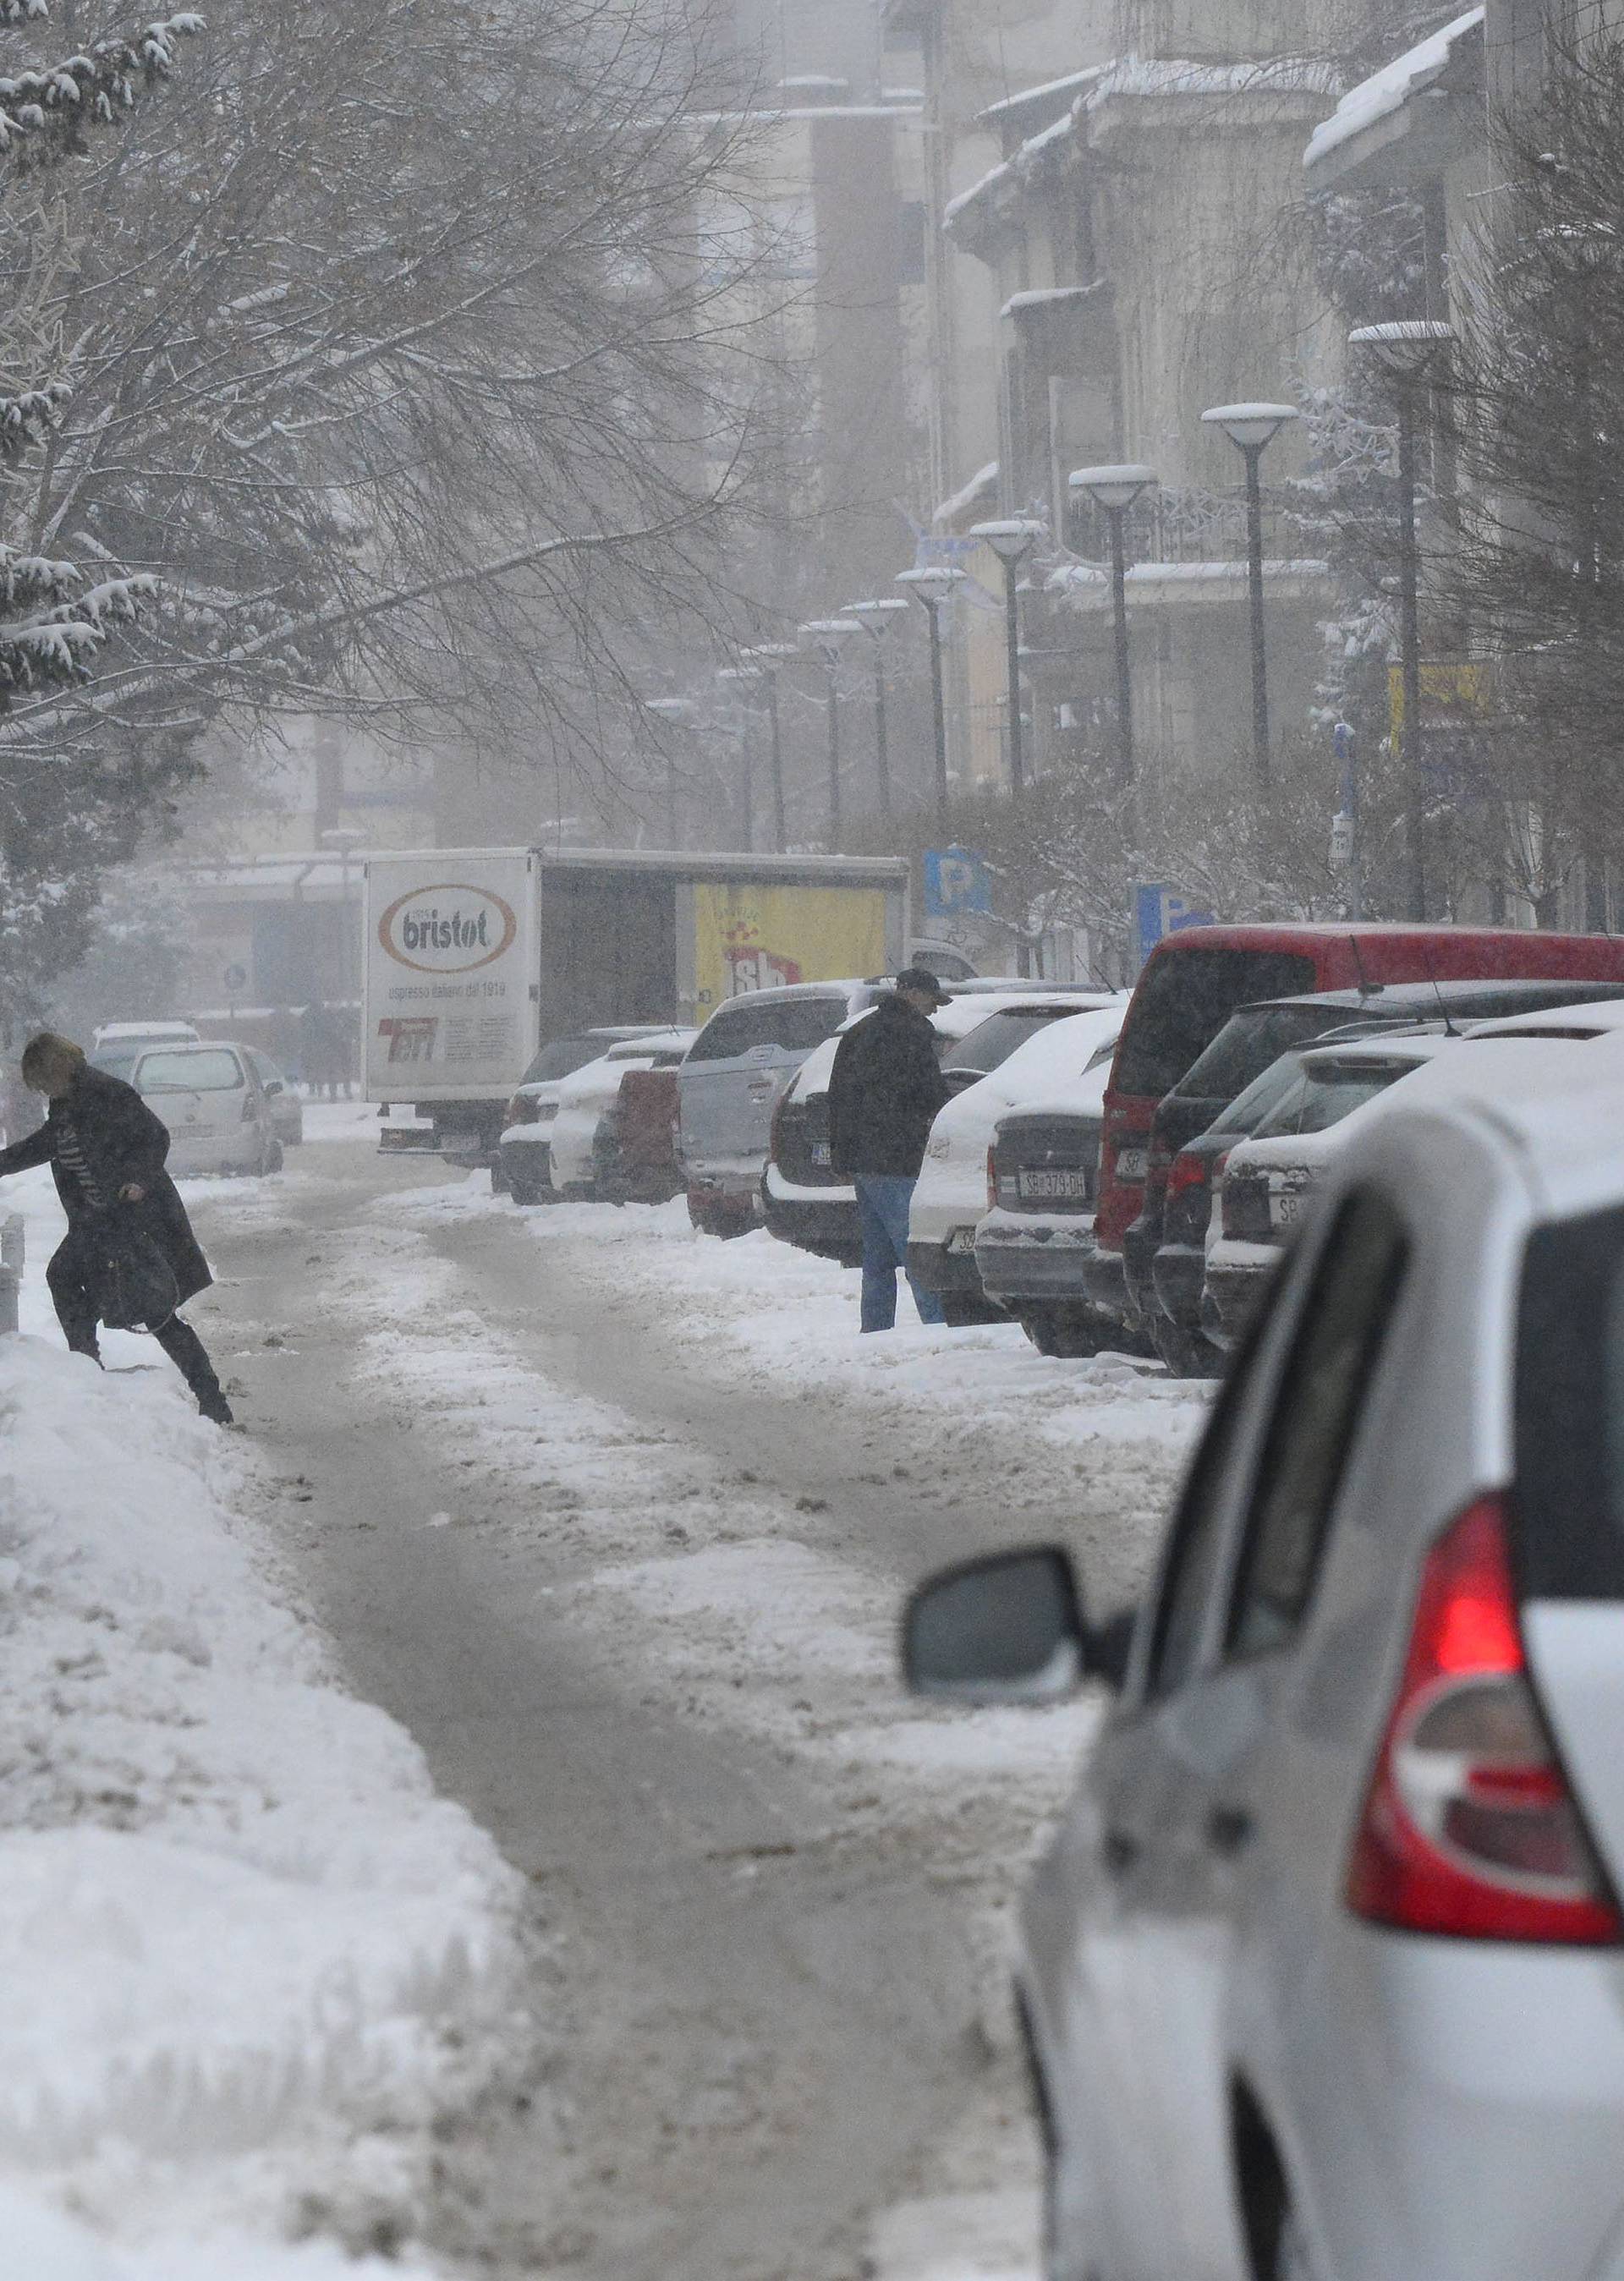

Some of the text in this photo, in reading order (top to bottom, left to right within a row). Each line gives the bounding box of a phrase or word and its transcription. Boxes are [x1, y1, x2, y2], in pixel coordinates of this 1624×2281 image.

[939, 858, 974, 905] P
[403, 908, 487, 950] bristot
[1160, 891, 1191, 936] P
